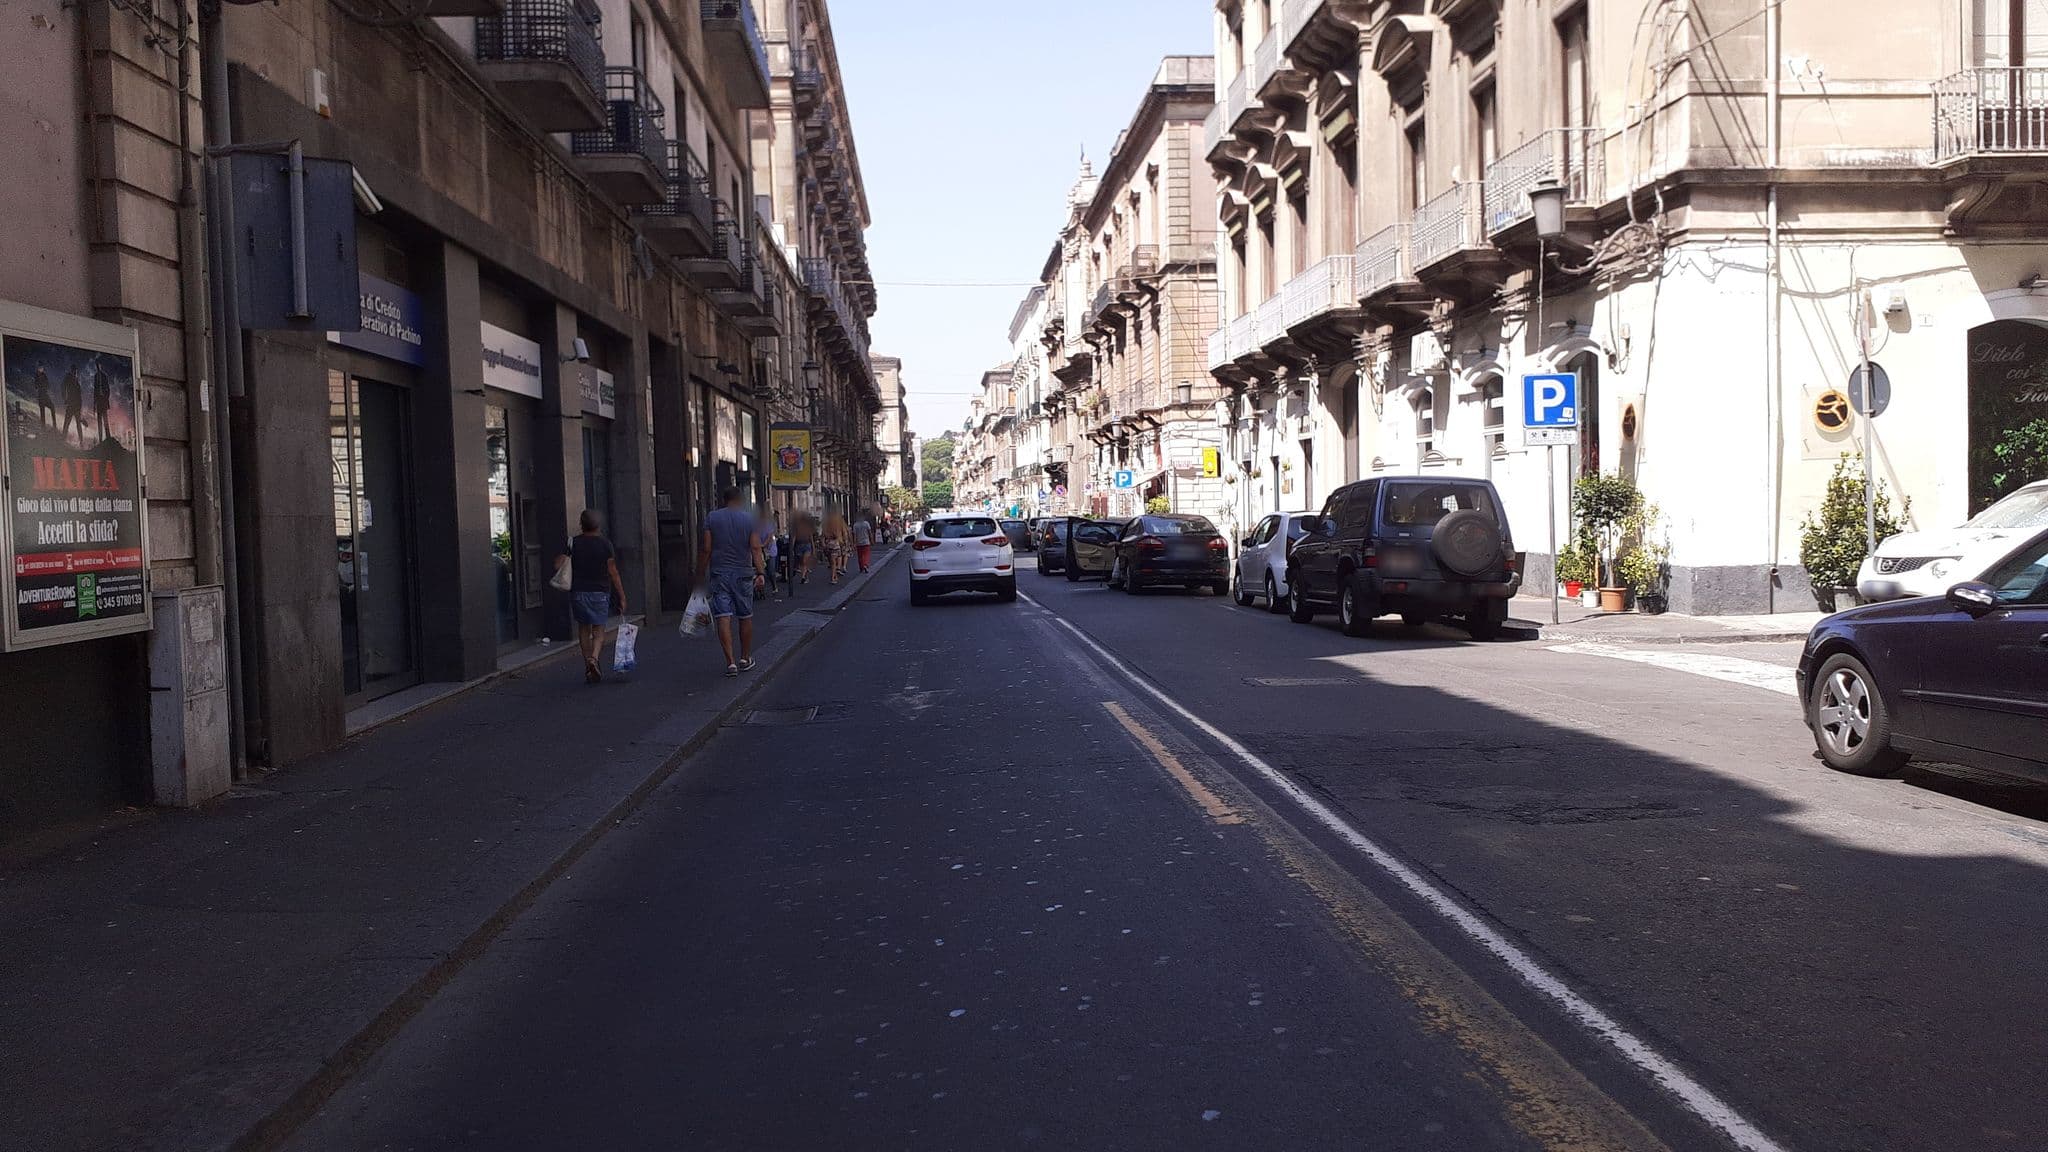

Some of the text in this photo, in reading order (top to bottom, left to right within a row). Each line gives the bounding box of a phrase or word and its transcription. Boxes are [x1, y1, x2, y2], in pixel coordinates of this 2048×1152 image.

[367, 293, 374, 310] di
[375, 295, 401, 320] Credito
[389, 320, 396, 337] di
[397, 323, 421, 346] Pachino
[1533, 379, 1566, 422] P
[32, 456, 119, 491] MAFIA
[1119, 473, 1128, 486] P
[17, 497, 38, 513] Gioco
[41, 497, 52, 512] dal
[54, 498, 68, 512] vivo
[70, 497, 77, 512] di
[95, 497, 112, 512] dalla
[113, 499, 132, 512] stanza
[38, 519, 119, 545] Accetti la sfida?
[104, 595, 115, 609] 345
